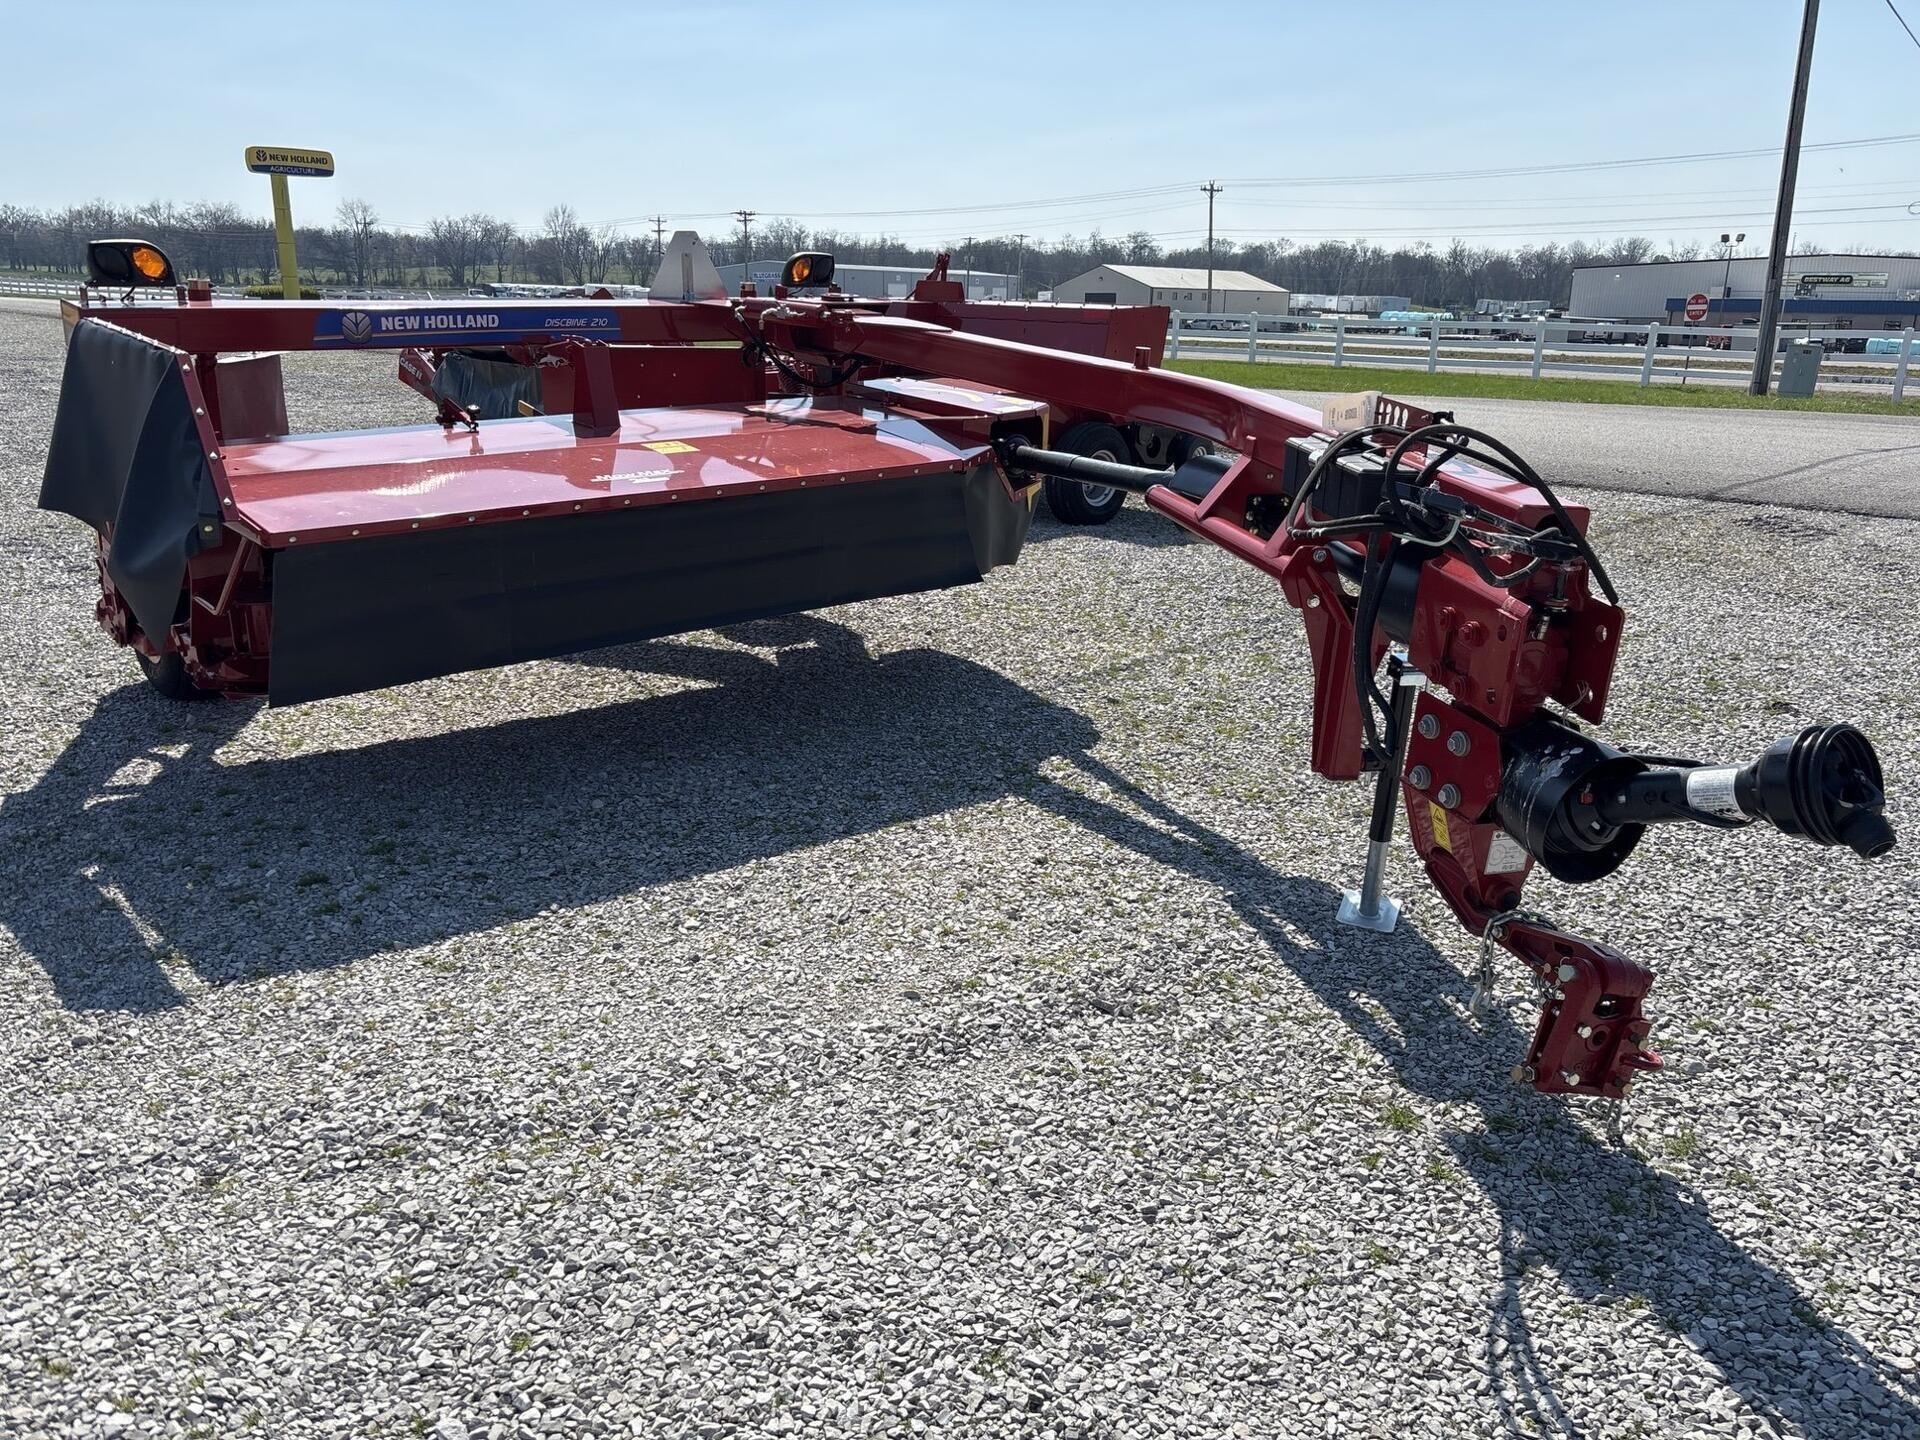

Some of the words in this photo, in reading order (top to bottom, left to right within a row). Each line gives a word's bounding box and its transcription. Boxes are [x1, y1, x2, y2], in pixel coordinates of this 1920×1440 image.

[268, 153, 289, 162] NEW
[290, 156, 328, 165] HOLLAND
[270, 166, 315, 174] AGRICULTURE
[381, 316, 420, 330] NEW
[423, 314, 500, 329] HOLLAND
[544, 318, 588, 328] DISCBINE
[590, 318, 608, 327] 210
